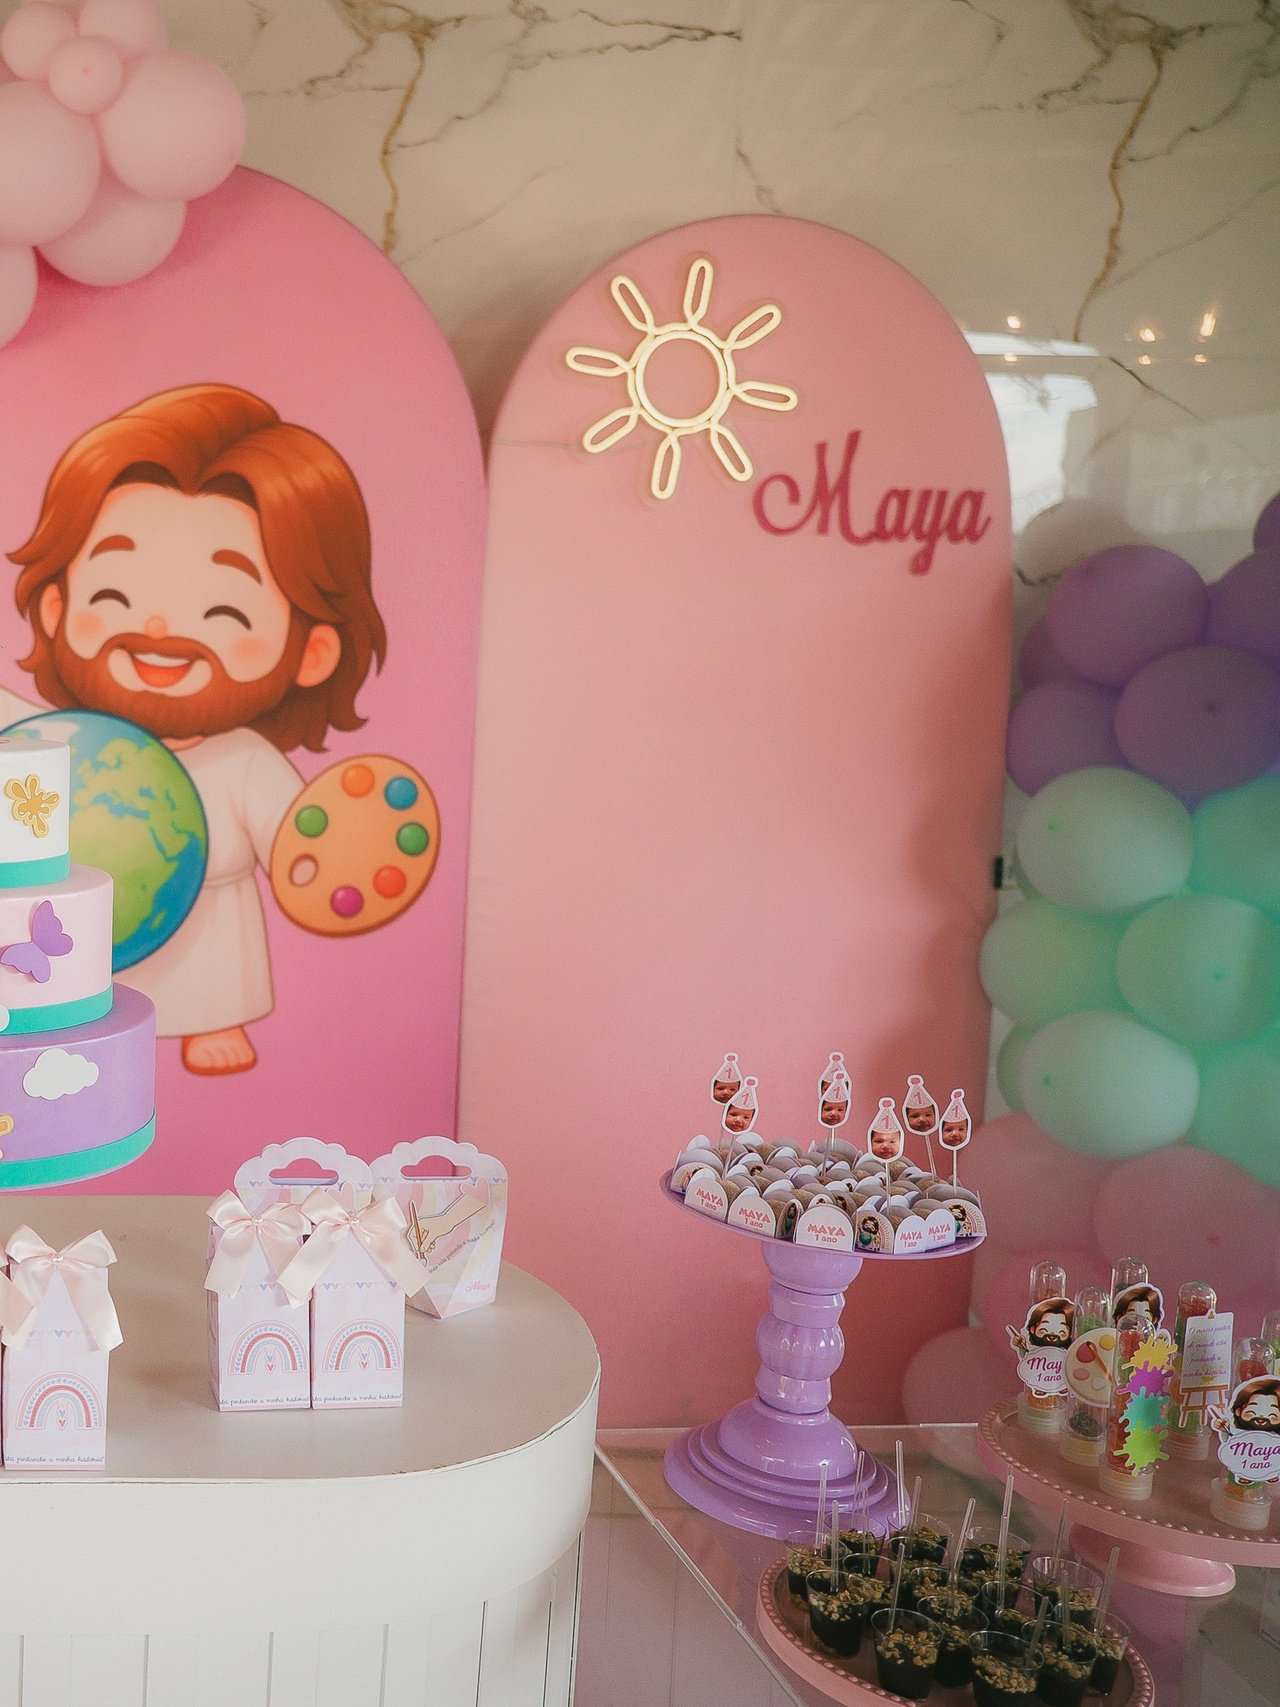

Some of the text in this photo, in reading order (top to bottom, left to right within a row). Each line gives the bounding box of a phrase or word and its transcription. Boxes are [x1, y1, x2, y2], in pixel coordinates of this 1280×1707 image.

[752, 429, 992, 576] Maya
[725, 1068, 732, 1079] 1
[742, 1092, 750, 1105] 1
[833, 1086, 840, 1099] 1
[914, 1092, 922, 1104] 1
[952, 1105, 959, 1118] 1
[882, 1115, 889, 1129] 1
[696, 1188, 724, 1207] MAYA
[705, 1202, 717, 1211] ano
[738, 1207, 771, 1223] MAYA
[806, 1223, 846, 1237] MAYA
[900, 1231, 922, 1240] MAYA
[928, 1223, 951, 1235] MAYA
[1027, 1357, 1062, 1374] May
[1037, 1373, 1042, 1382] 1
[1230, 1442, 1280, 1461] Maya
[1242, 1460, 1247, 1469] 1
